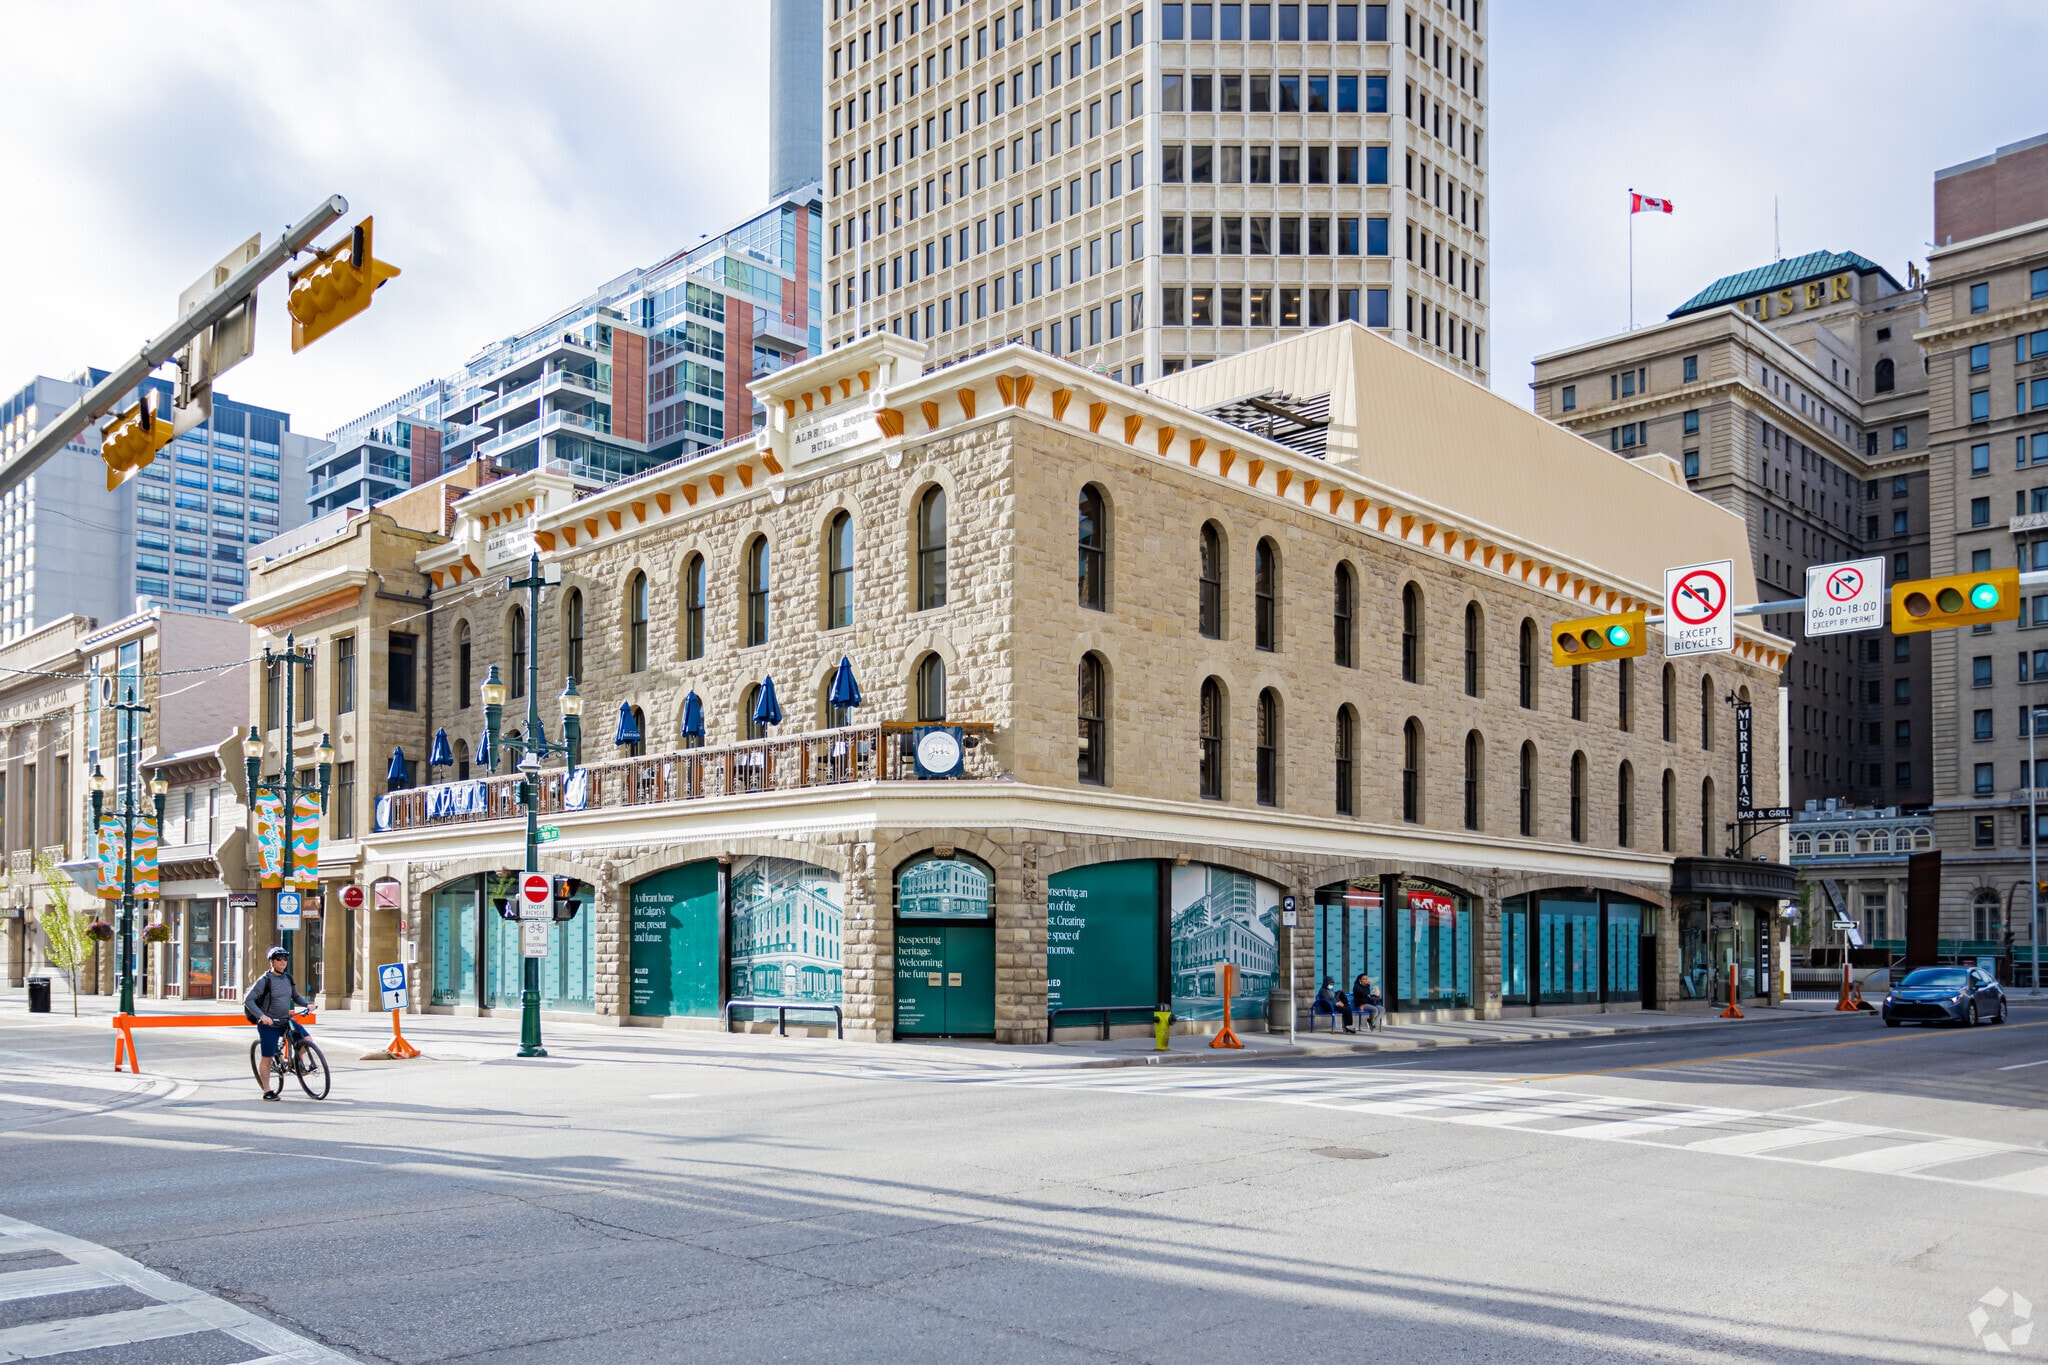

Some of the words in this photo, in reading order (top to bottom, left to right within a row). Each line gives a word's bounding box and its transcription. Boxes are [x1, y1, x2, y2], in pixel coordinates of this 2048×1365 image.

[843, 411, 872, 428] HOTE
[64, 443, 99, 456] ARRIO
[1811, 601, 1877, 619] 06:00-18:00
[1812, 619, 1837, 630] EXCEPT
[1839, 618, 1849, 626] BY
[1850, 614, 1875, 625] PERMIT
[1679, 626, 1718, 640] EXCEPT
[1674, 636, 1723, 651] BICYCLES
[1738, 709, 1750, 807] MURRIETA'S
[1738, 811, 1755, 819] BAR
[1758, 811, 1765, 819] &
[1768, 808, 1791, 818] GRILL
[639, 892, 657, 903] vibrant
[658, 892, 674, 903] home
[1079, 889, 1088, 898] an
[230, 899, 257, 908] patagonia
[1056, 901, 1064, 911] of
[1065, 901, 1076, 911] the
[634, 906, 642, 916] for
[646, 921, 667, 931] present
[1057, 916, 1085, 928] Creating
[634, 932, 645, 942] and
[898, 935, 941, 946] Respecting
[1053, 932, 1071, 942] space
[1072, 930, 1080, 940] of
[898, 946, 932, 957] heritage.
[898, 958, 943, 968] Welcoming
[898, 969, 911, 979] the
[912, 969, 929, 979] futu
[433, 989, 455, 1000] ALLIED
